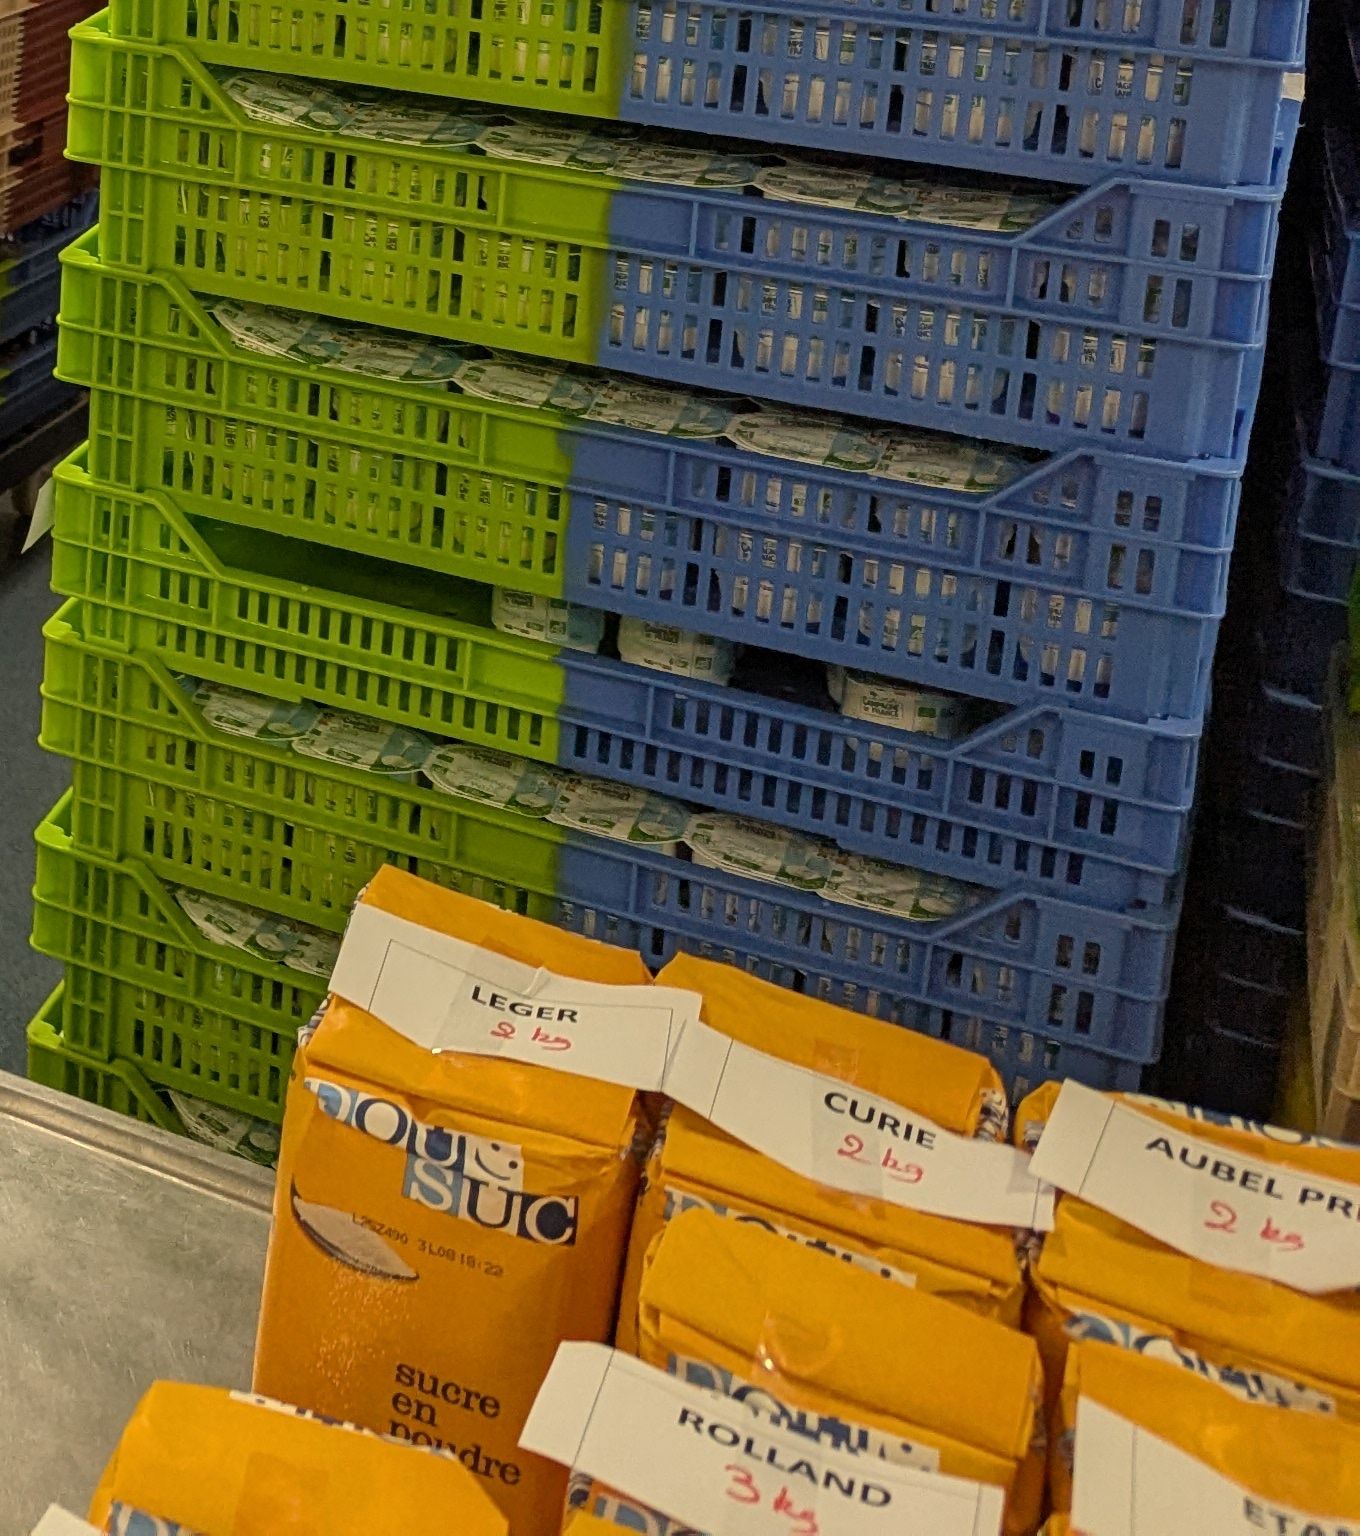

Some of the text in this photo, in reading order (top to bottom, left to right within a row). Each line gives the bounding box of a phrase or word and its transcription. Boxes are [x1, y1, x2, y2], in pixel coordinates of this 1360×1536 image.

[471, 985, 578, 1024] LEGER
[490, 1021, 517, 1040] 2
[823, 1091, 937, 1151] CURIE
[836, 1134, 924, 1184] 2 kg
[1145, 1136, 1284, 1200] AUBEL
[409, 1160, 577, 1246] SUC
[1204, 1200, 1238, 1234] 2
[391, 1391, 438, 1427] en
[394, 1362, 501, 1419] sucre
[677, 1406, 892, 1507] ROLLAND
[724, 1464, 760, 1504] 3
